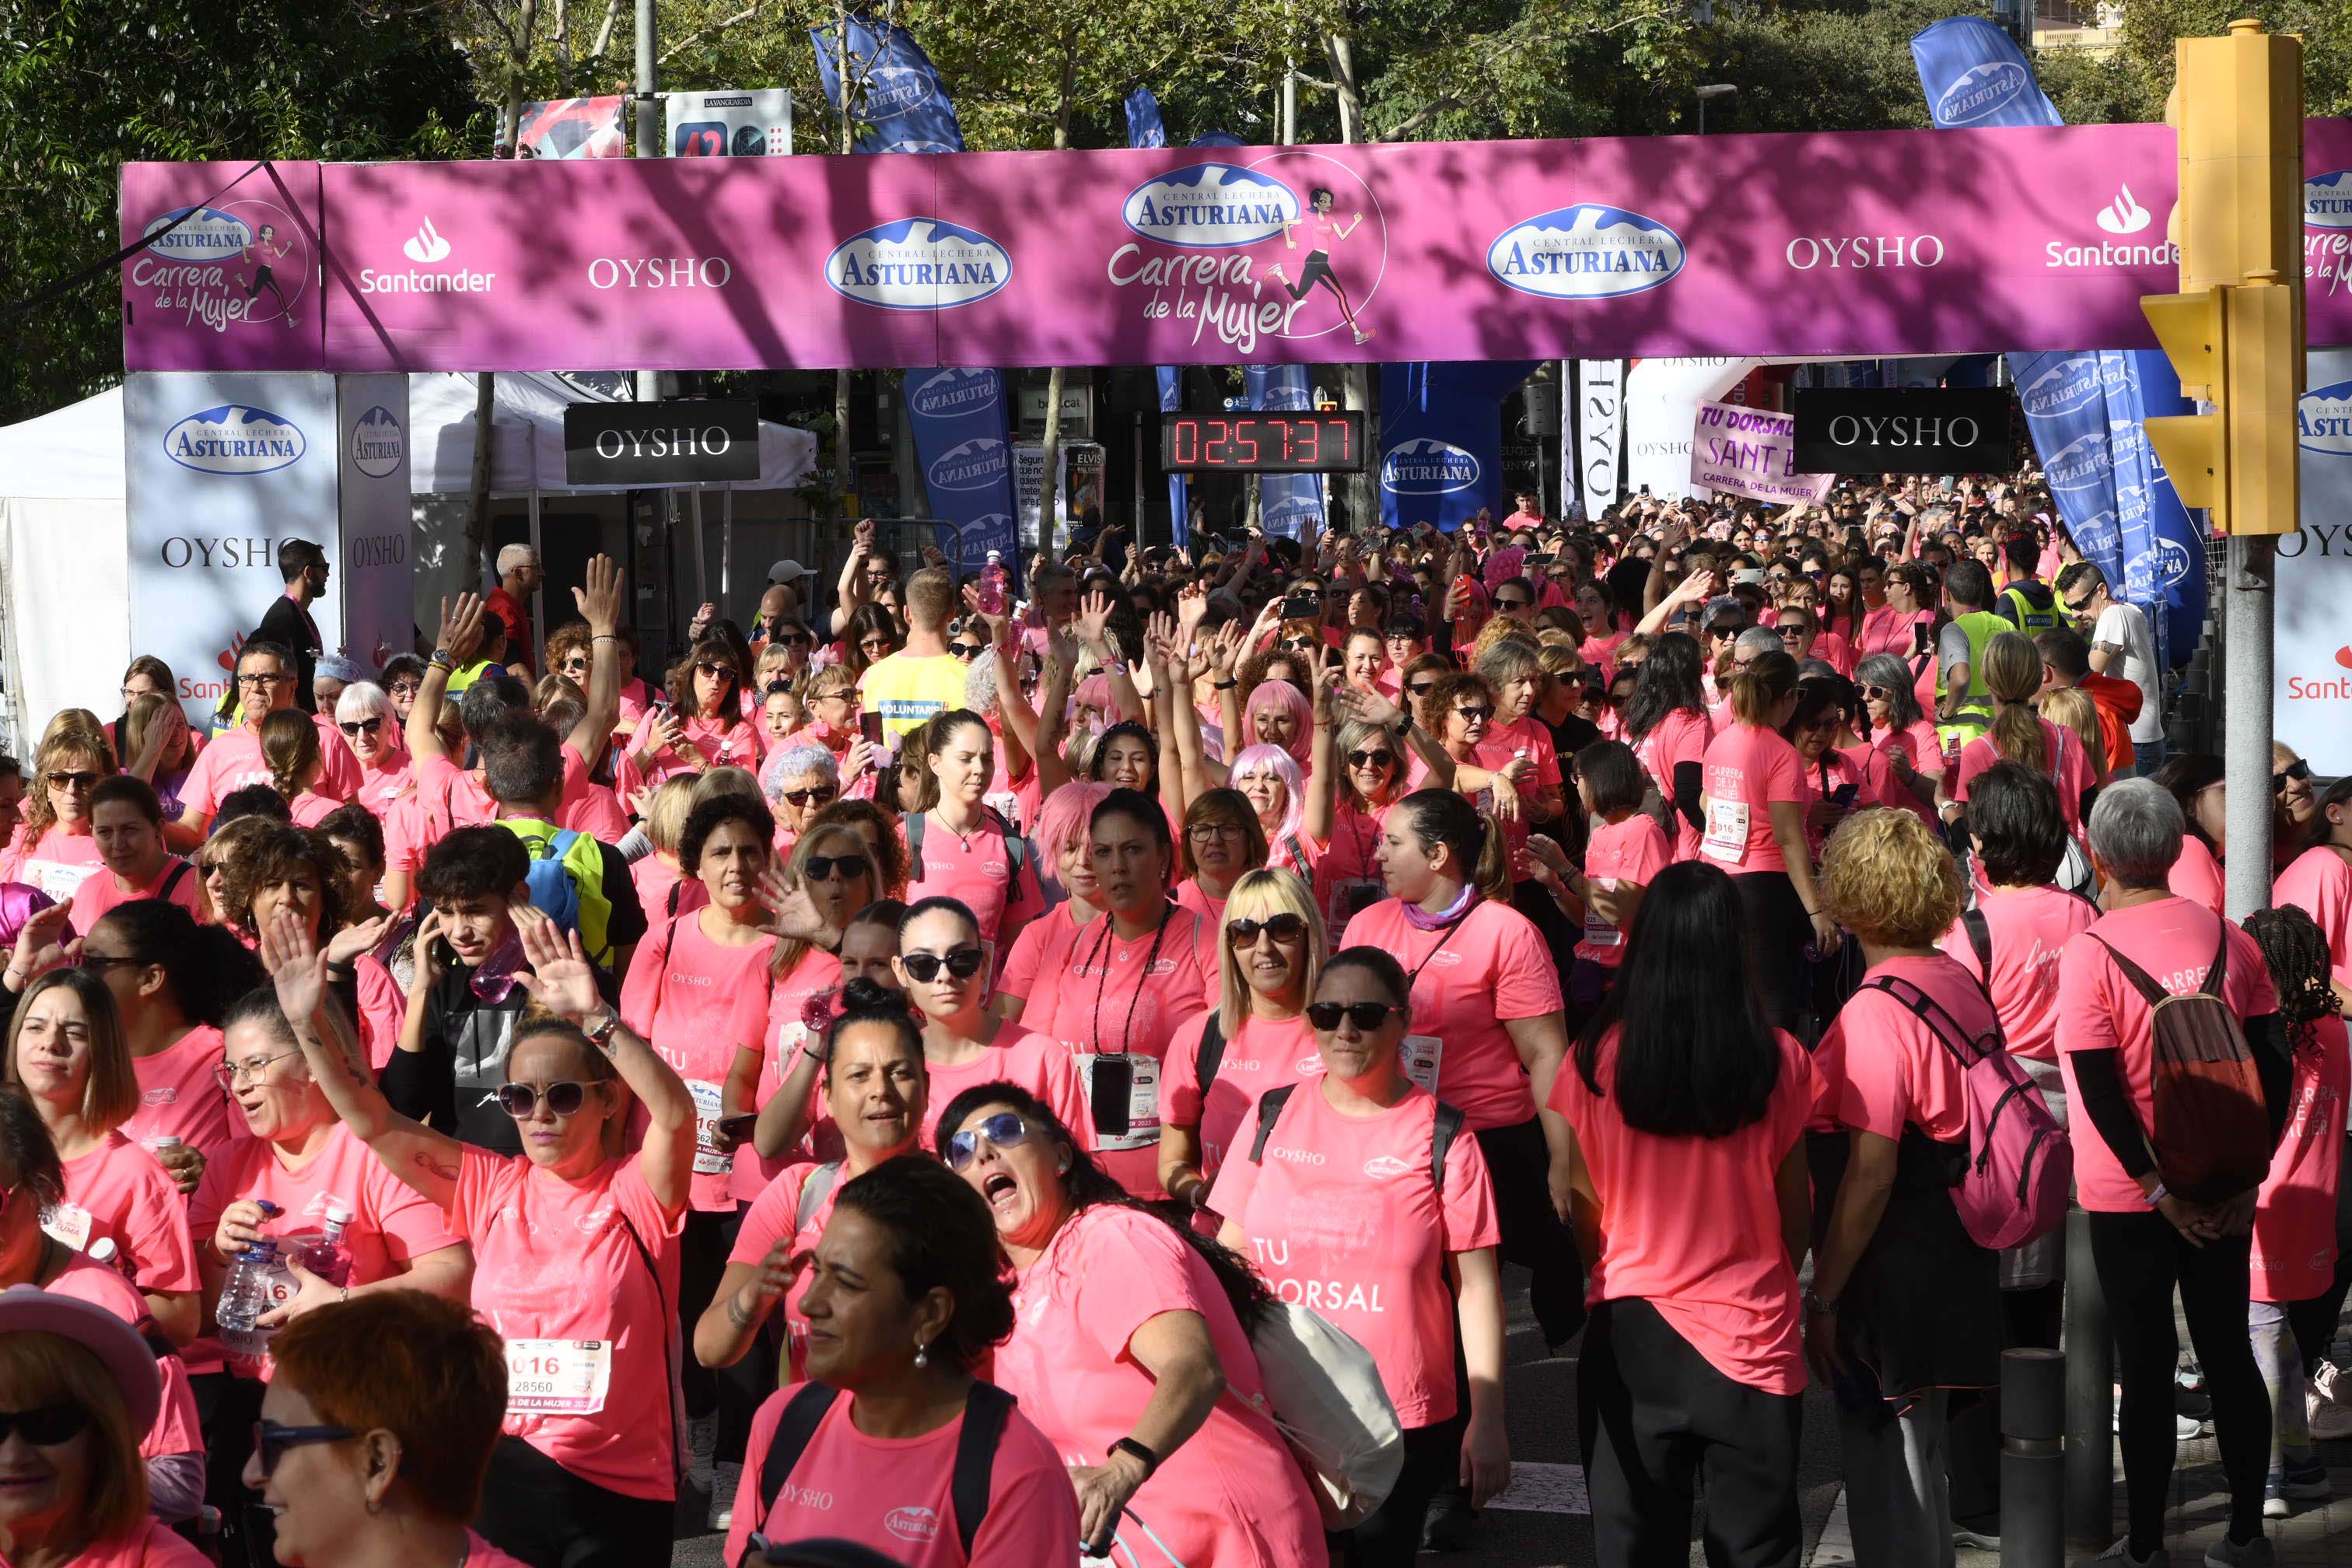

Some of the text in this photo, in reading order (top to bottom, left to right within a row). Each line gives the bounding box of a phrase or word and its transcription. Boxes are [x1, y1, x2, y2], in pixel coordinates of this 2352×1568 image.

[1163, 191, 1282, 202] CENTRAL LECHERA
[1136, 194, 1286, 227] ASTURIANA
[868, 248, 992, 260] CENTRAL LECHERA
[1532, 236, 1664, 248] CENTRAL LECHERA
[1786, 235, 1944, 270] OYSHO
[2046, 240, 2181, 268] Santande
[839, 252, 998, 286] ASTURIANA
[1107, 242, 1251, 287] Carrera
[1502, 240, 1671, 276] ASTURIANA
[2318, 256, 2333, 278] la
[132, 257, 224, 287] Carrera
[360, 268, 495, 294] Santander
[588, 257, 732, 289] OYSHO
[155, 289, 188, 309] de la
[186, 285, 259, 333] Mujer
[1143, 288, 1195, 320] de la
[1191, 281, 1307, 354] Mujer
[1700, 407, 1724, 427] TU
[175, 430, 296, 458] ASTURIANA
[197, 428, 292, 437] CENTRAL LECHERA
[595, 425, 731, 459] OYSHO
[1175, 420, 1349, 464] 02:57:37
[1829, 415, 1979, 447] OYSHO
[355, 432, 401, 460] ASTURIANA
[1077, 454, 1102, 464] ELVIS
[1704, 437, 1777, 474] SANT
[1384, 460, 1472, 483] ASTURIANA
[1703, 472, 1812, 497] CARRERA DE LA MUJER
[1020, 497, 1035, 506] este
[161, 537, 300, 568] OYSH
[352, 534, 404, 569] OYSHO
[1708, 765, 1744, 781] CARRERA
[1716, 777, 1738, 789] DE LA
[1717, 823, 1734, 834] 016
[924, 862, 954, 871] YSHO
[671, 972, 712, 987] OYSHO
[660, 1045, 686, 1071] TU
[1273, 1146, 1325, 1166] OYSHO
[55, 1223, 80, 1237] SUMA
[1252, 1237, 1290, 1265] TU
[512, 1356, 560, 1375] 016
[515, 1381, 553, 1393] 28560
